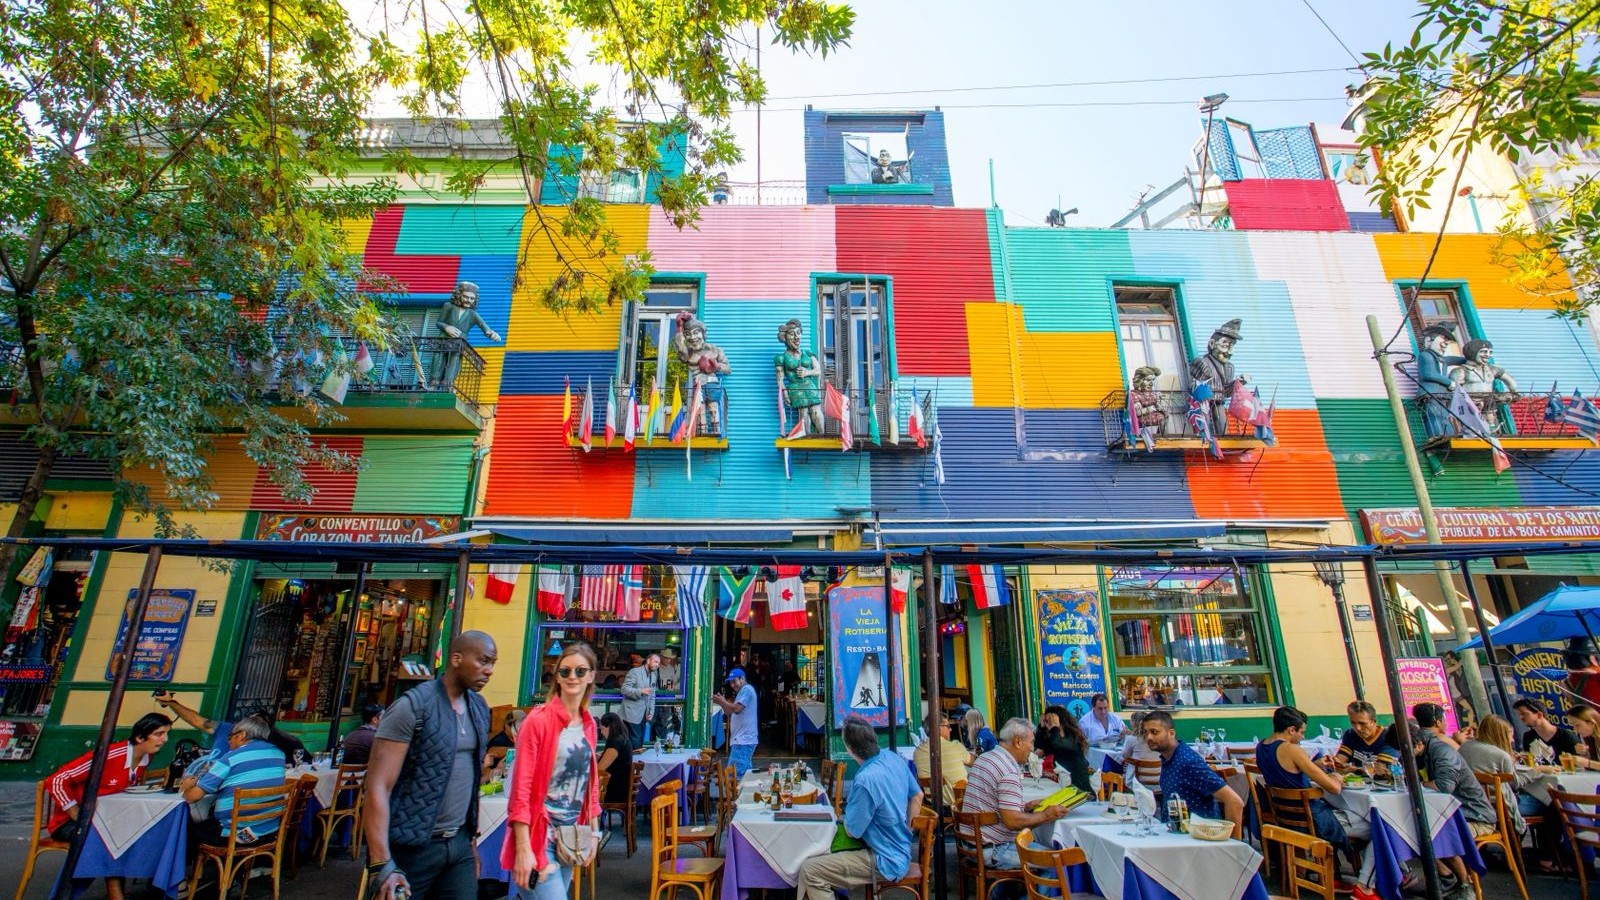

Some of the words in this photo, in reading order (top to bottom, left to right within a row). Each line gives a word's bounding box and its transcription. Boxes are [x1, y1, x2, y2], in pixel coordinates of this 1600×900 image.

[319, 517, 401, 531] CONVENTILLO
[1386, 512, 1439, 527] CENT
[1442, 513, 1509, 526] CULTURAL
[1533, 512, 1566, 525] LOS
[290, 527, 353, 543] CORAZON
[356, 533, 372, 543] DE
[378, 528, 423, 543] TANGO
[1440, 526, 1483, 537] EPUBLICA
[1488, 527, 1501, 537] DE
[1502, 527, 1517, 537] LA
[1516, 526, 1547, 537] BOCA
[1550, 525, 1599, 537] CAMINITO
[860, 608, 872, 616] LA
[1053, 617, 1088, 633] VIEJA
[846, 645, 872, 653] RESTO
[1397, 660, 1441, 674] ENVENIDOS
[1514, 653, 1568, 676] CONVENT
[0, 669, 44, 679] LFAJORES
[1047, 689, 1069, 697] Carnes
[1521, 677, 1563, 695] HISTO
